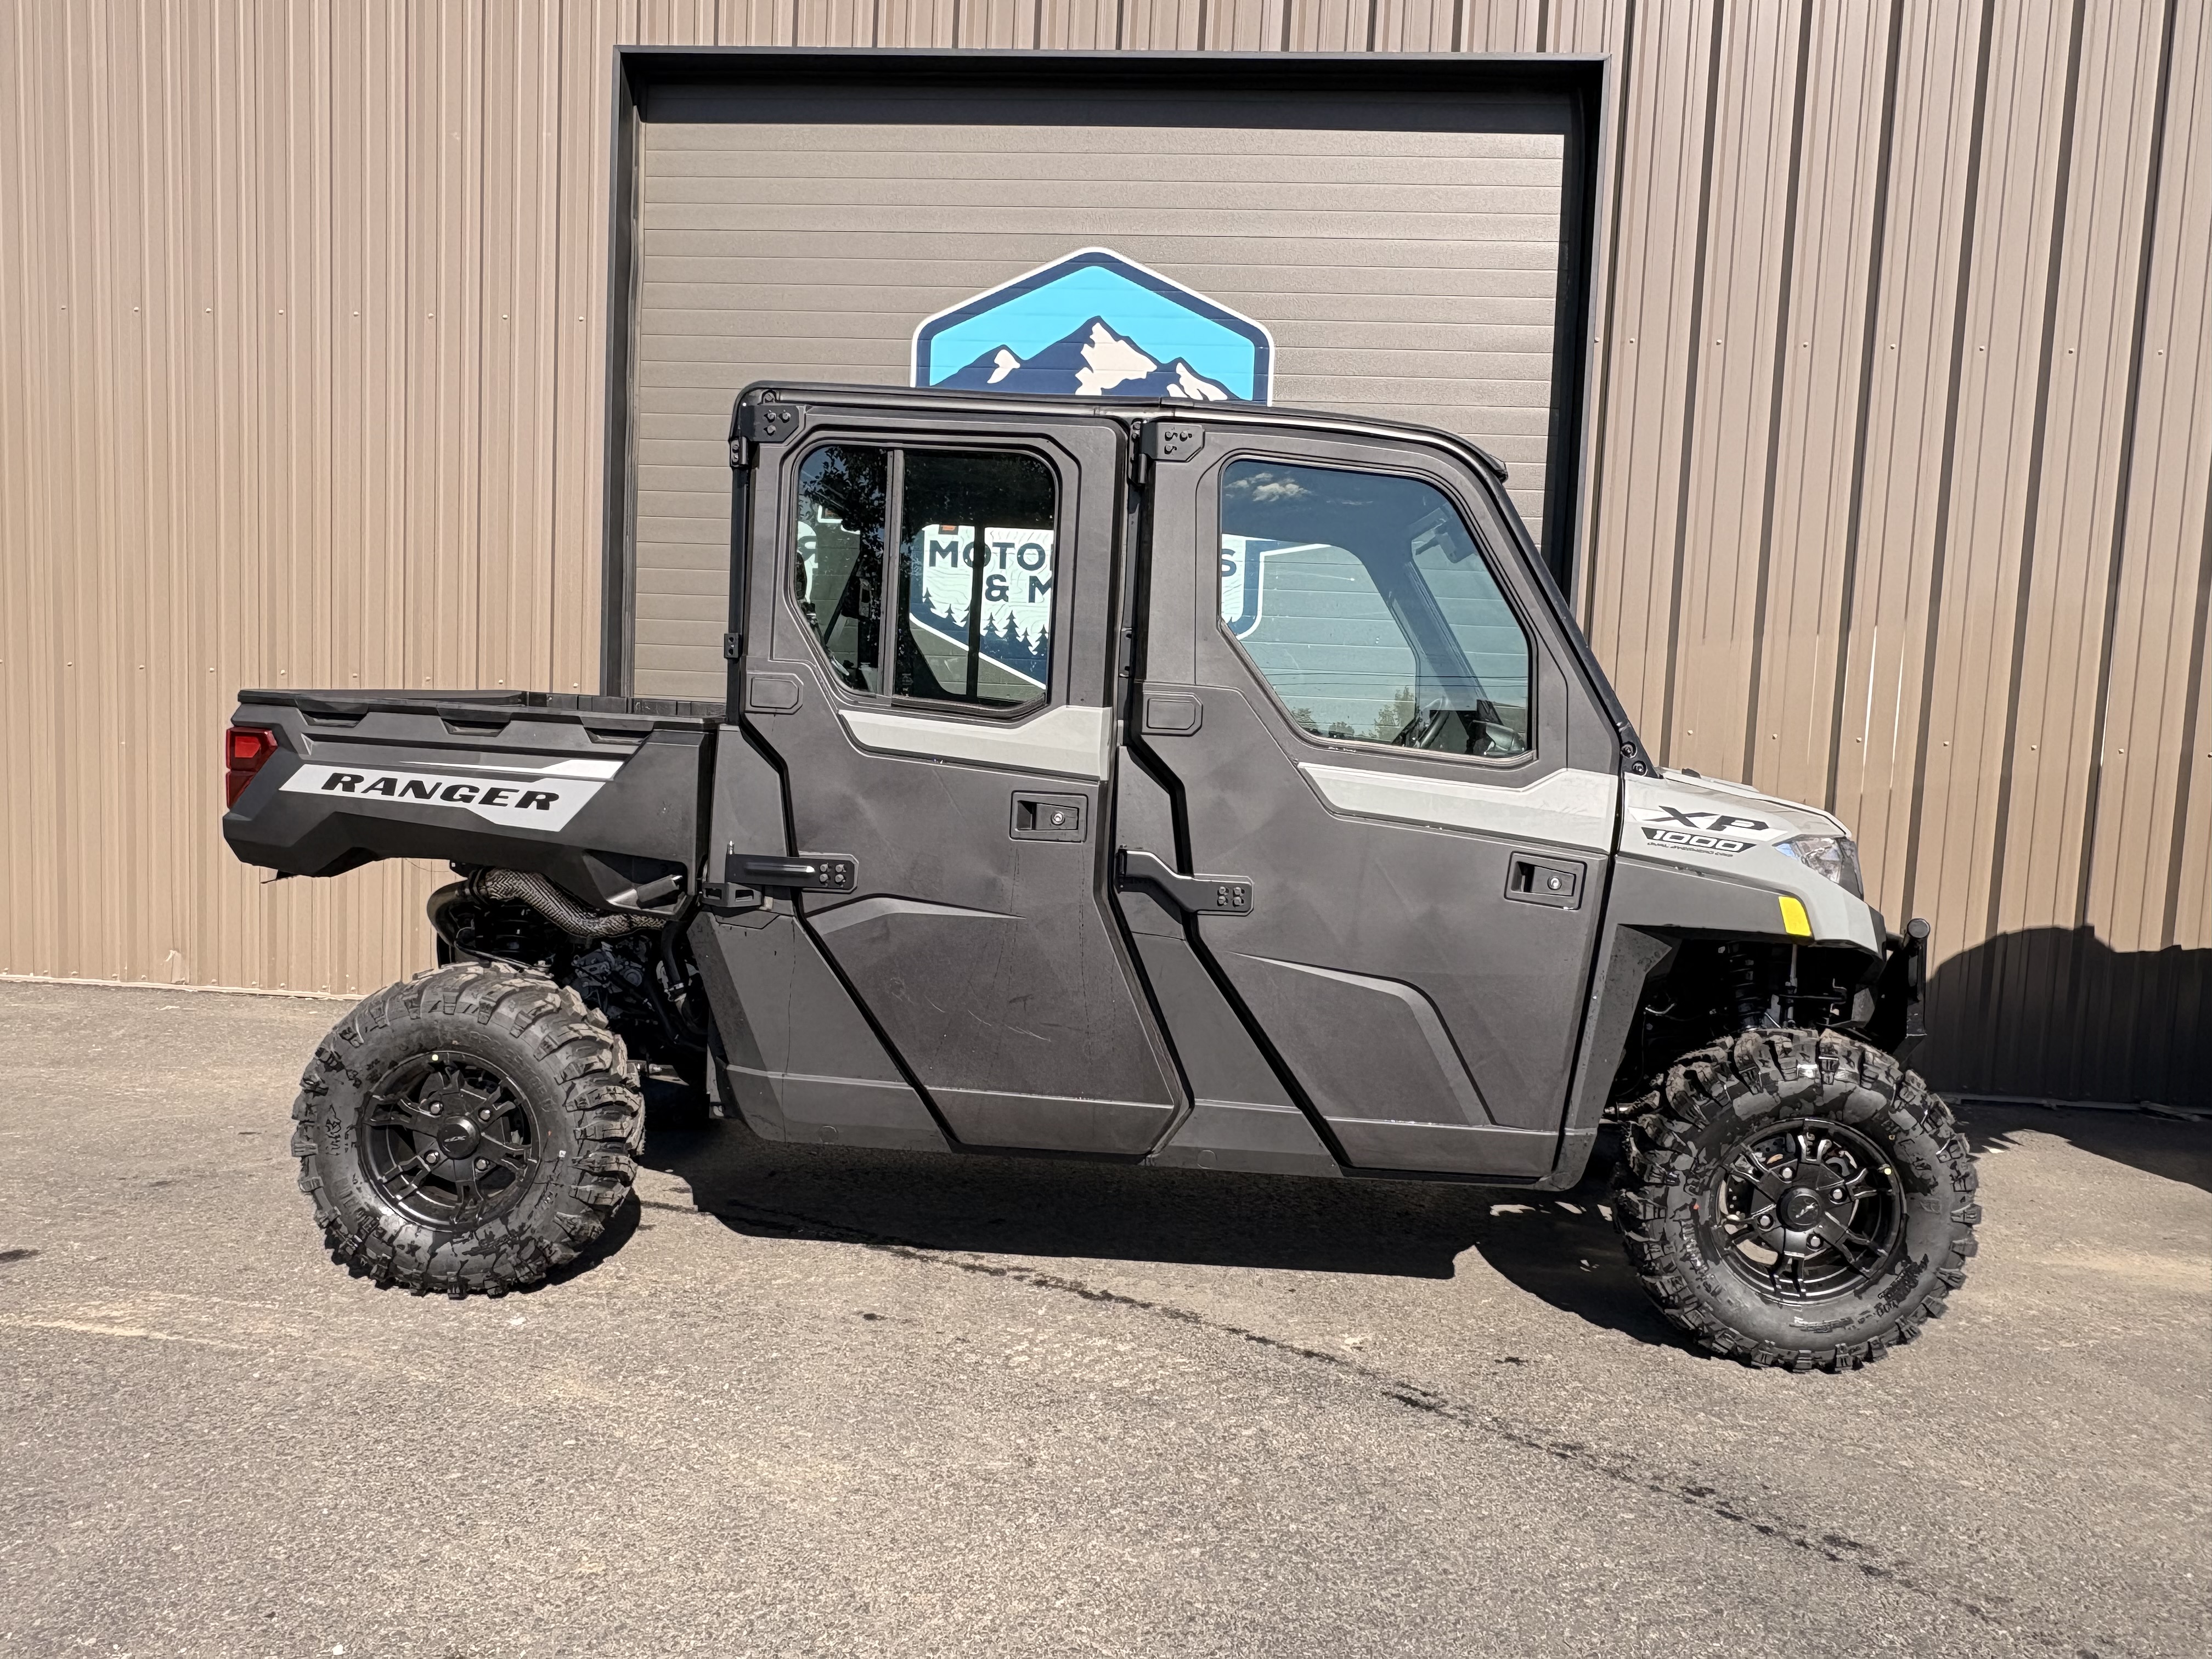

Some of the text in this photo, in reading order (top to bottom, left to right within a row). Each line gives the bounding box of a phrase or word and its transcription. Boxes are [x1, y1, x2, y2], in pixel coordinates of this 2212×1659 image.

[929, 539, 1054, 571] MOTO
[985, 574, 1009, 602] &
[321, 772, 560, 811] RANGER
[1642, 805, 1770, 832] XP
[1652, 830, 1744, 851] 1000
